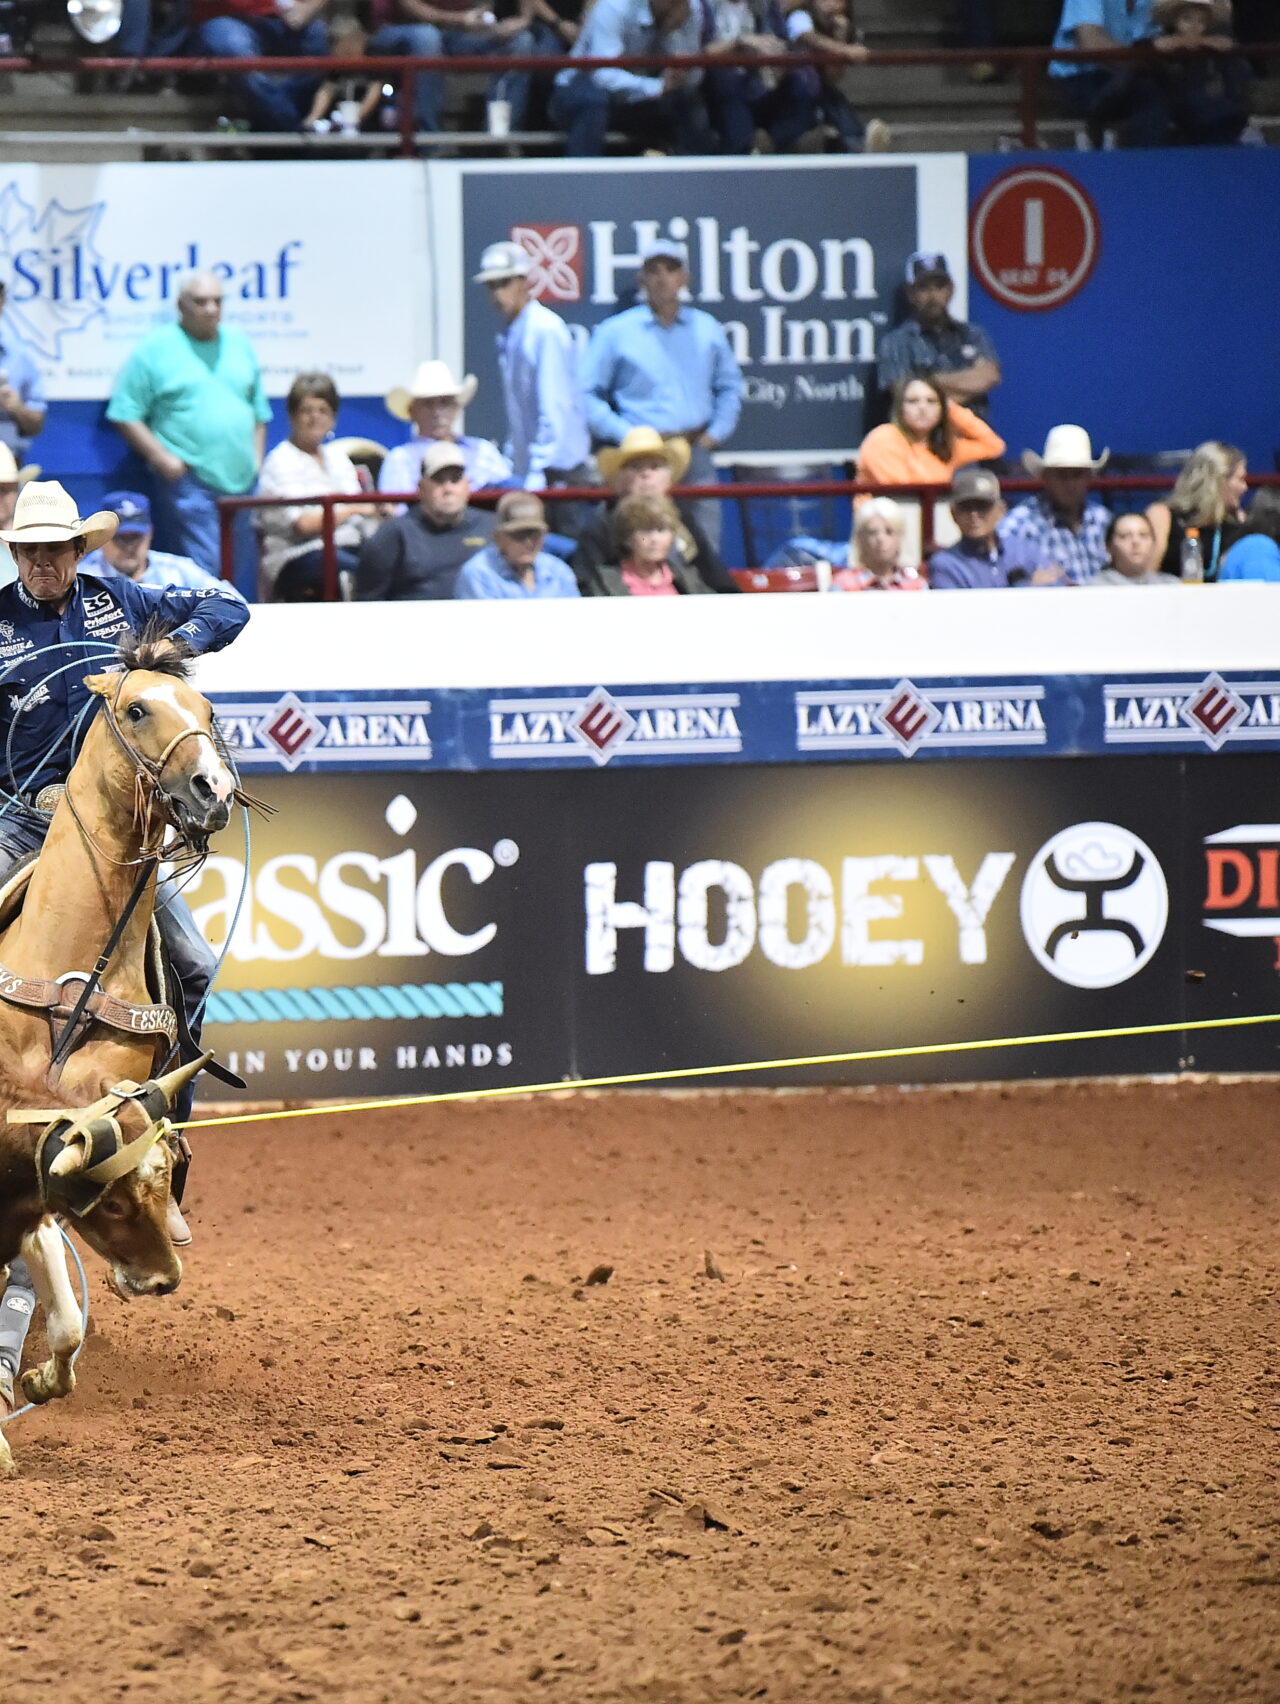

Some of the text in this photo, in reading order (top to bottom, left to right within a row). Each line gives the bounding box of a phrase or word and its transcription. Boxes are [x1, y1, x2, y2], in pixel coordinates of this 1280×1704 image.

[760, 306, 875, 365] Inn
[794, 374, 865, 401] North
[491, 714, 570, 744] LAZY
[634, 708, 740, 739] ARENA
[798, 704, 876, 734] LAZY
[940, 700, 1045, 731] ARENA
[1104, 697, 1182, 728] LAZY
[220, 717, 261, 748] ZY
[325, 715, 432, 746] ARENA
[175, 794, 496, 962] assic
[583, 850, 1017, 976] HOOEY
[229, 1042, 514, 1075] IN YOUR HANDS
